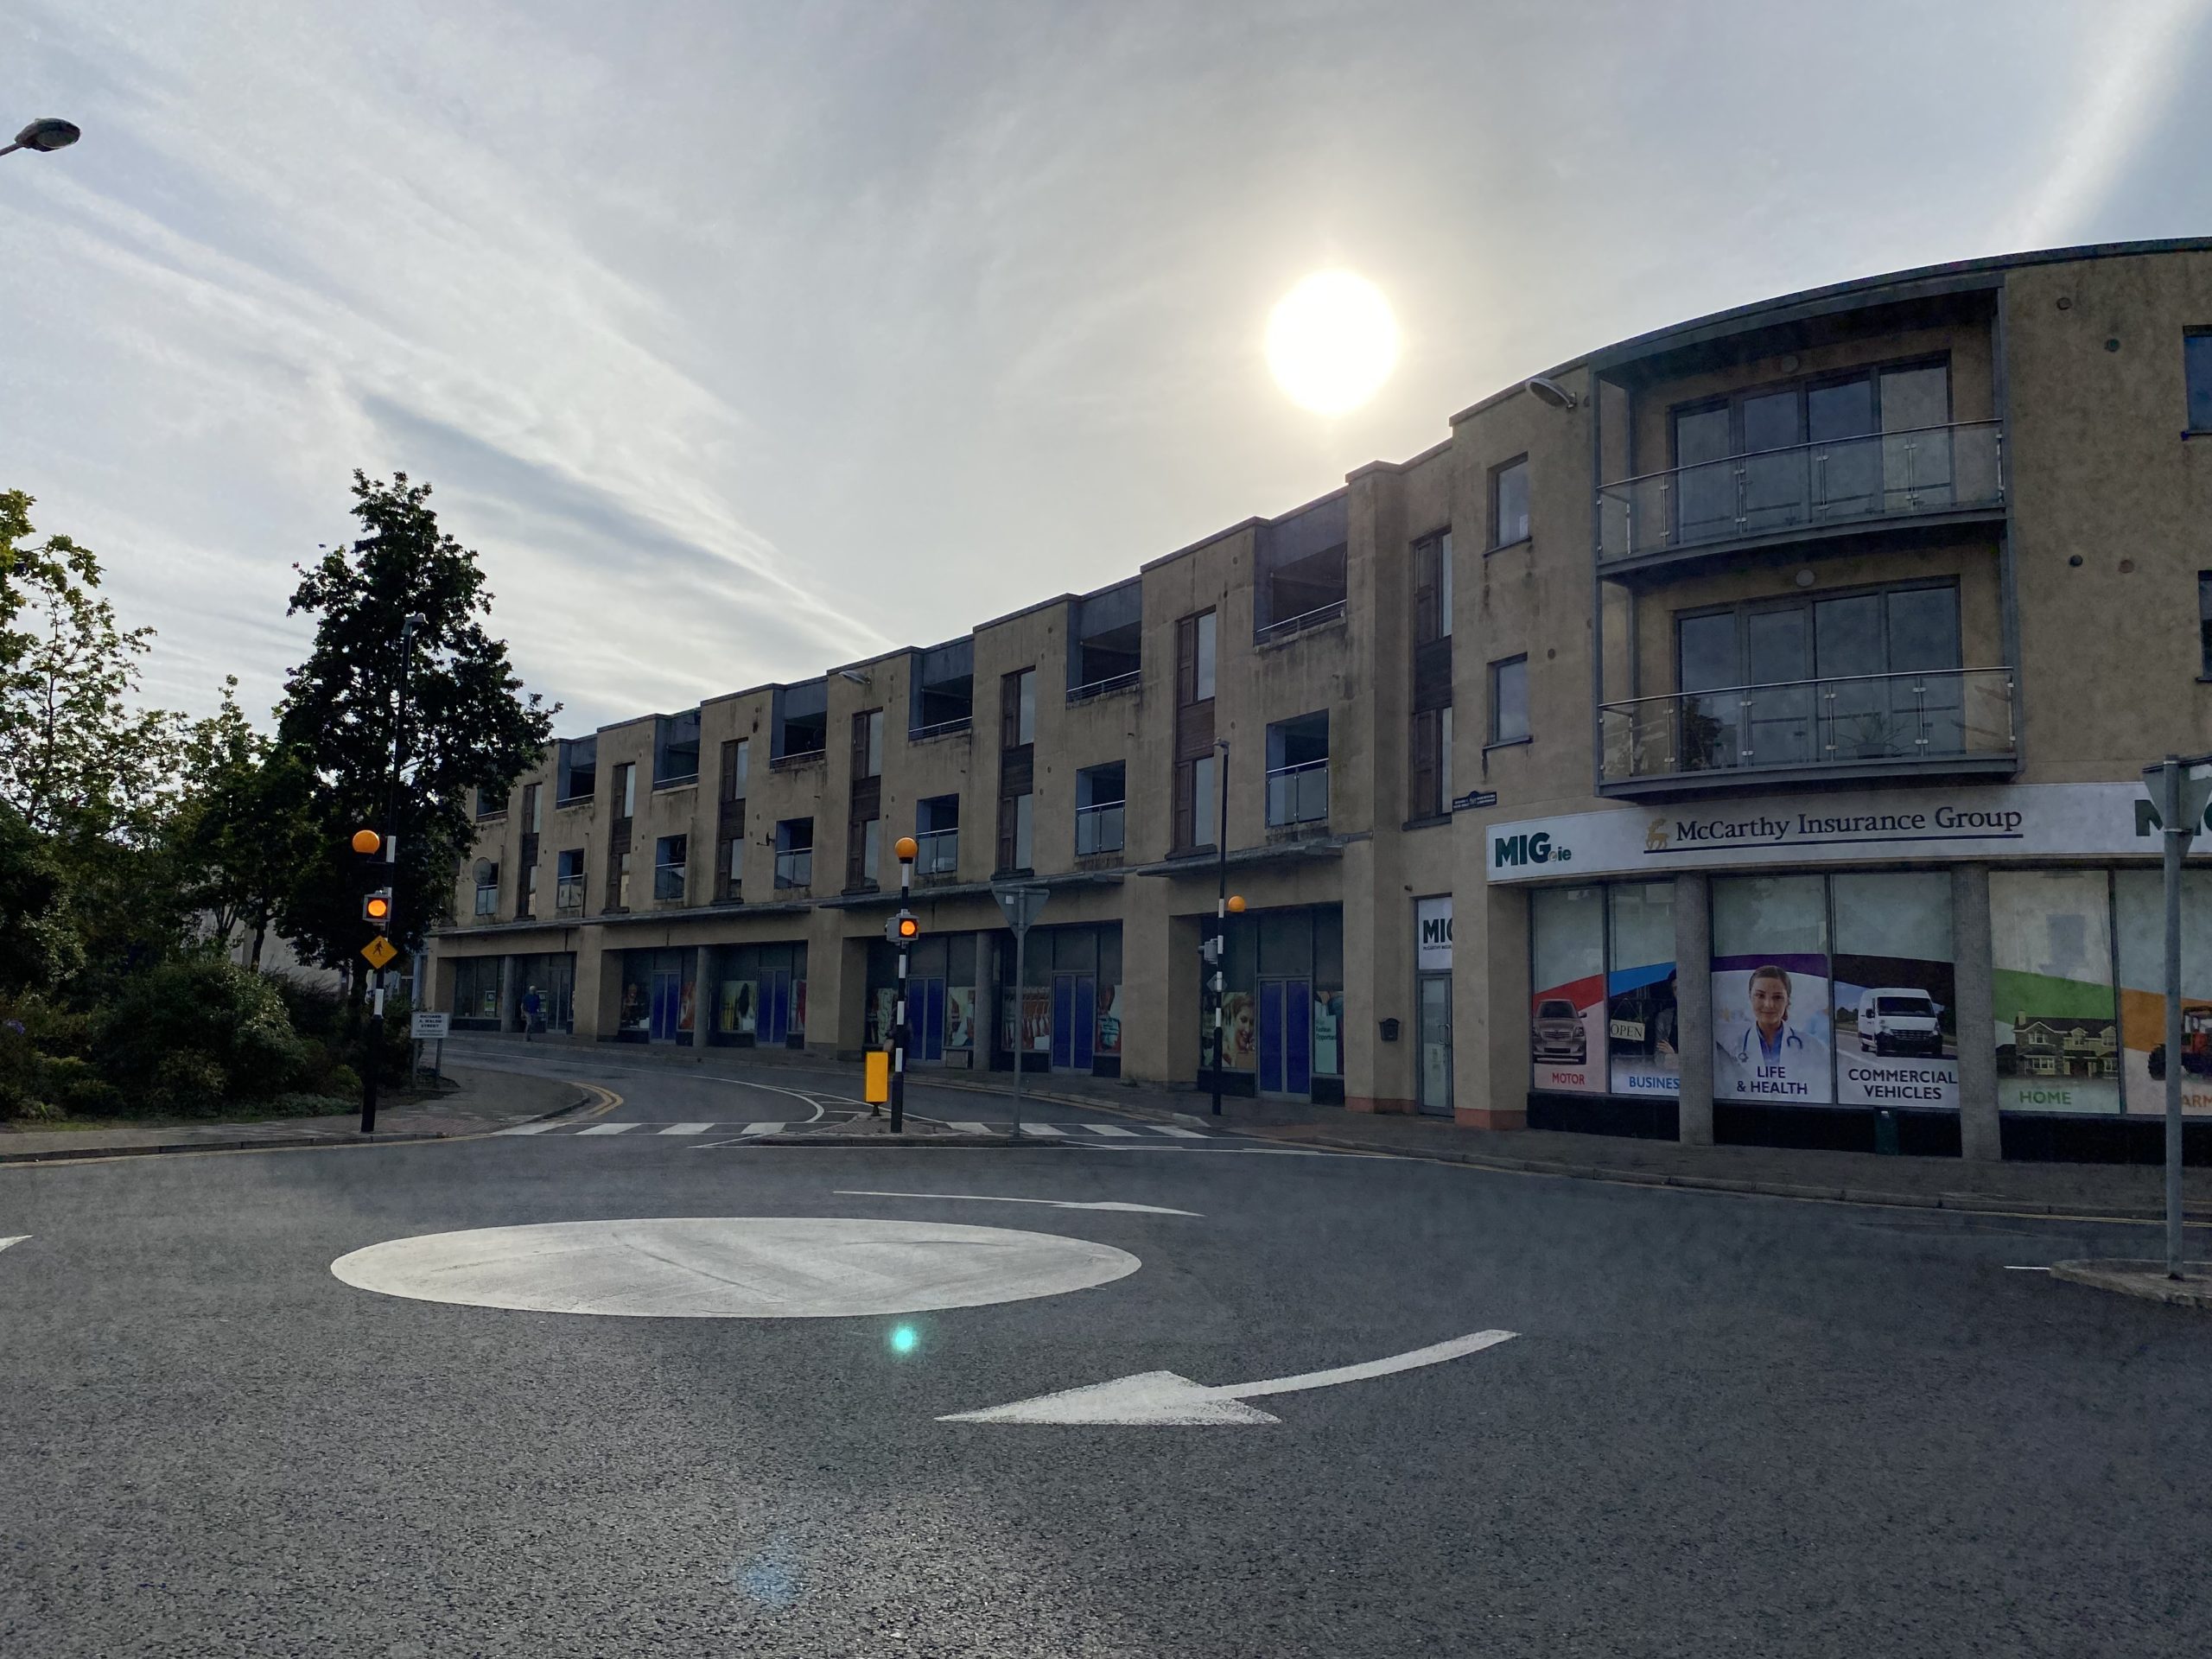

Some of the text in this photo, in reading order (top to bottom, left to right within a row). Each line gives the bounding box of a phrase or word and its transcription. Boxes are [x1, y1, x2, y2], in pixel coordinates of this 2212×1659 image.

[1676, 806, 2023, 841] McCarthy Insurance Group
[1611, 1023, 1643, 1038] OPEN
[1552, 1071, 1585, 1085] MOTOR
[1758, 1065, 1786, 1078] LIFE
[1848, 1068, 1958, 1084] COMMERCIAL
[1629, 1076, 1680, 1090] BUSINES
[1737, 1080, 1808, 1095] & HEALTH
[1864, 1085, 1942, 1100] VEHICLES
[2019, 1090, 2072, 1104] HOME
[2183, 1095, 2212, 1107] ARM
